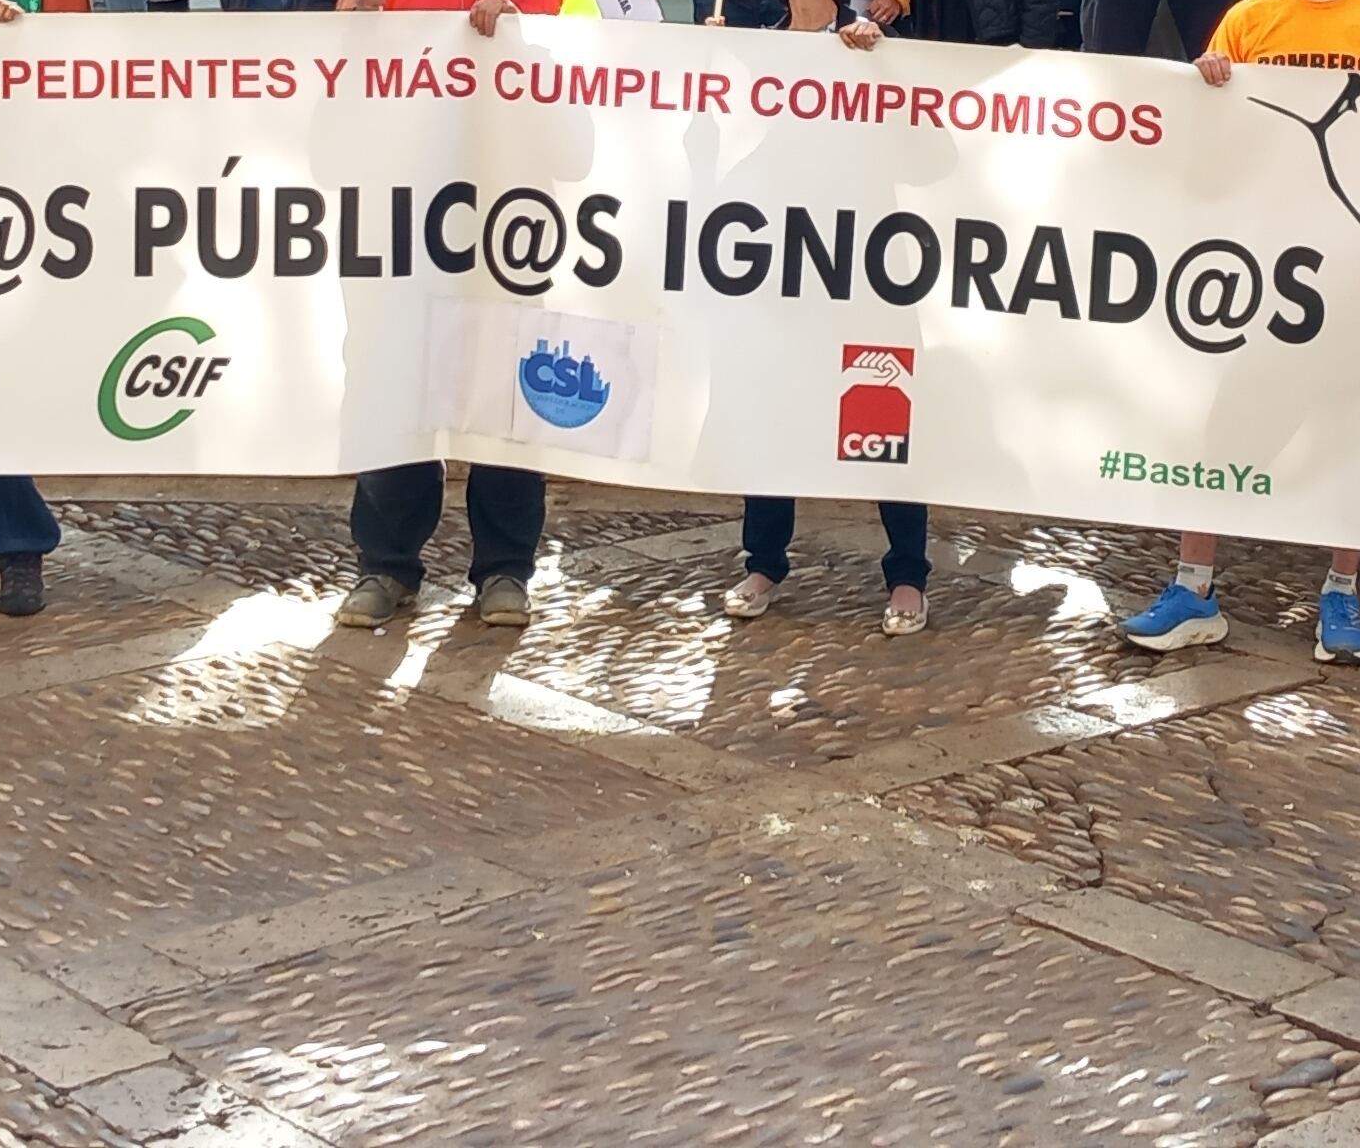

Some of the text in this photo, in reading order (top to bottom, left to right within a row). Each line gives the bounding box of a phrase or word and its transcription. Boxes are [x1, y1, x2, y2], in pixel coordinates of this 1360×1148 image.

[313, 58, 348, 99] Y
[364, 46, 477, 100] MÁS
[494, 59, 732, 114] CUMPLIR
[750, 76, 1163, 147] COMPROMISOS
[133, 155, 624, 297] PÚBLIC@S
[663, 200, 1326, 355] IGNORAD@S
[125, 354, 232, 399] CSIF
[525, 353, 604, 404] CSL
[842, 432, 905, 461] CGT
[1098, 449, 1273, 497] #BastaYa
